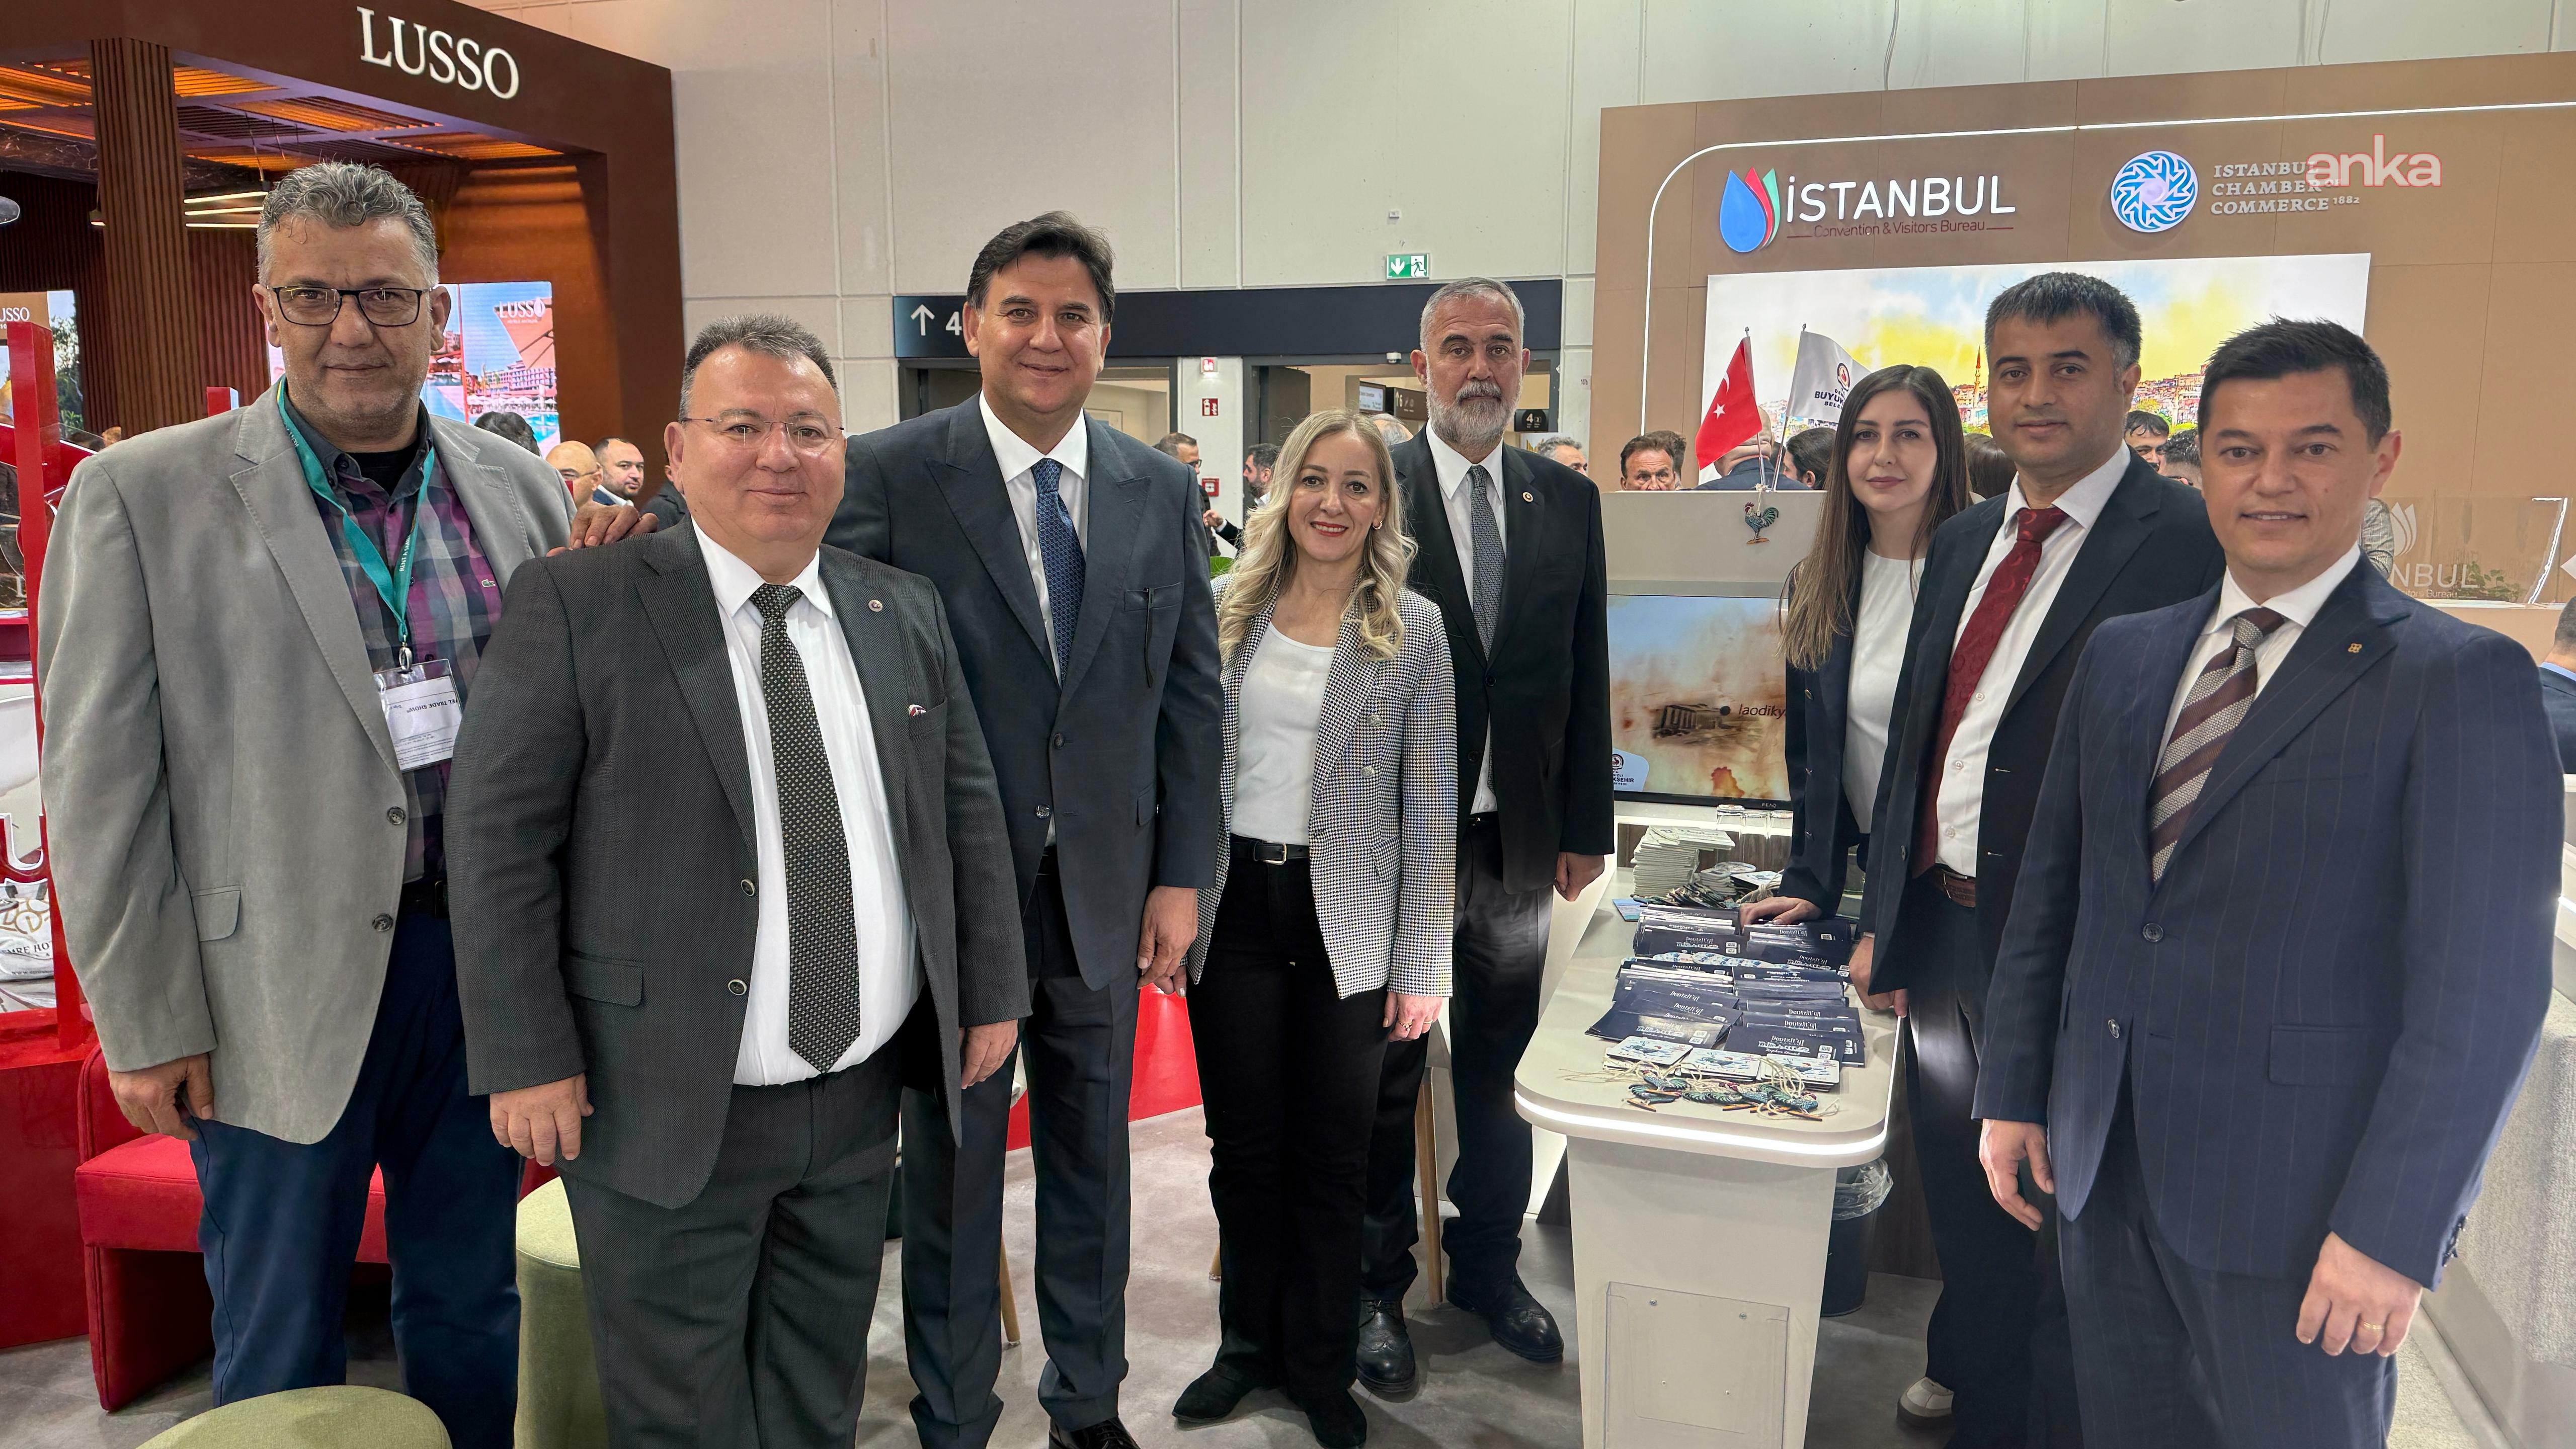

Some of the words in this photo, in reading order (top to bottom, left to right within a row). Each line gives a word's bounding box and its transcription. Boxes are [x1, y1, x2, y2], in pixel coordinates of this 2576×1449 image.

[357, 6, 519, 99] LUSSO
[2212, 179, 2322, 196] CHAMBER
[1787, 175, 2016, 222] İSTANBUL
[2210, 197, 2329, 215] COMMERCE
[2332, 195, 2360, 205] 1882
[1814, 223, 1879, 237] Convention
[1883, 223, 1892, 234] &
[1893, 221, 1937, 234] Visitors
[1941, 220, 1985, 232] Bureau
[0, 307, 30, 322] USSO
[499, 297, 545, 318] LUSSO
[946, 311, 962, 336] 4
[1526, 414, 1534, 423] 4
[2390, 562, 2479, 588] NBUL
[2426, 589, 2457, 598] Bureau
[1739, 704, 1786, 719] laodiky
